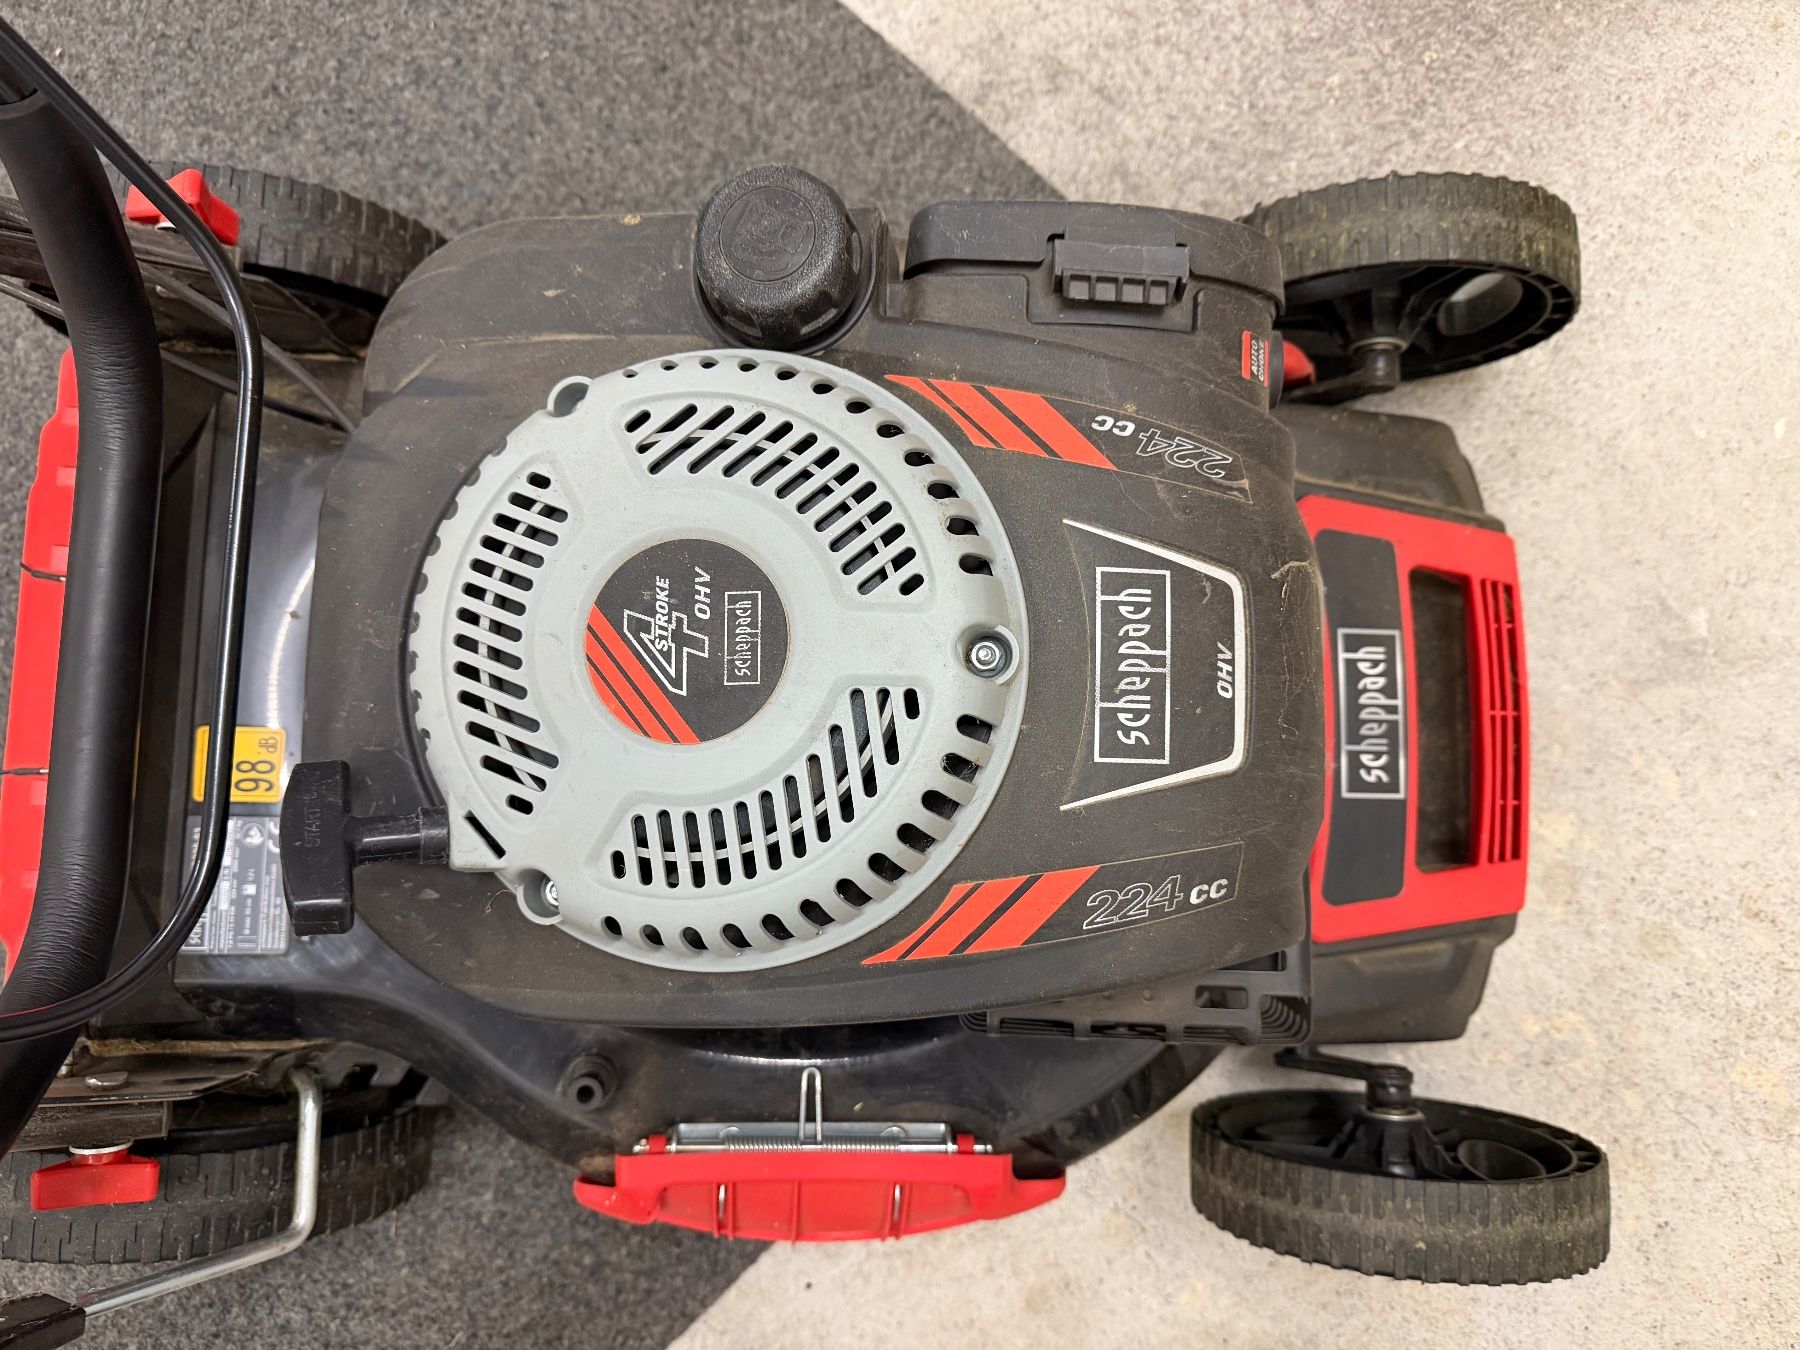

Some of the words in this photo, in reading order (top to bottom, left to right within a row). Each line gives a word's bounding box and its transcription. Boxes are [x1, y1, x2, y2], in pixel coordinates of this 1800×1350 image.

[1251, 340, 1259, 375] AUTO
[1258, 338, 1266, 381] CHOKE
[1135, 427, 1233, 478] 224
[655, 575, 670, 652] STROKE
[694, 566, 711, 620] OHV
[622, 608, 709, 697] 4
[725, 600, 760, 676] scheppach
[1099, 588, 1168, 746] scheppach
[1216, 641, 1233, 699] OHV
[1342, 645, 1400, 784] scheppach
[234, 759, 276, 793] 98
[258, 736, 279, 754] dB
[1083, 874, 1184, 930] 224
